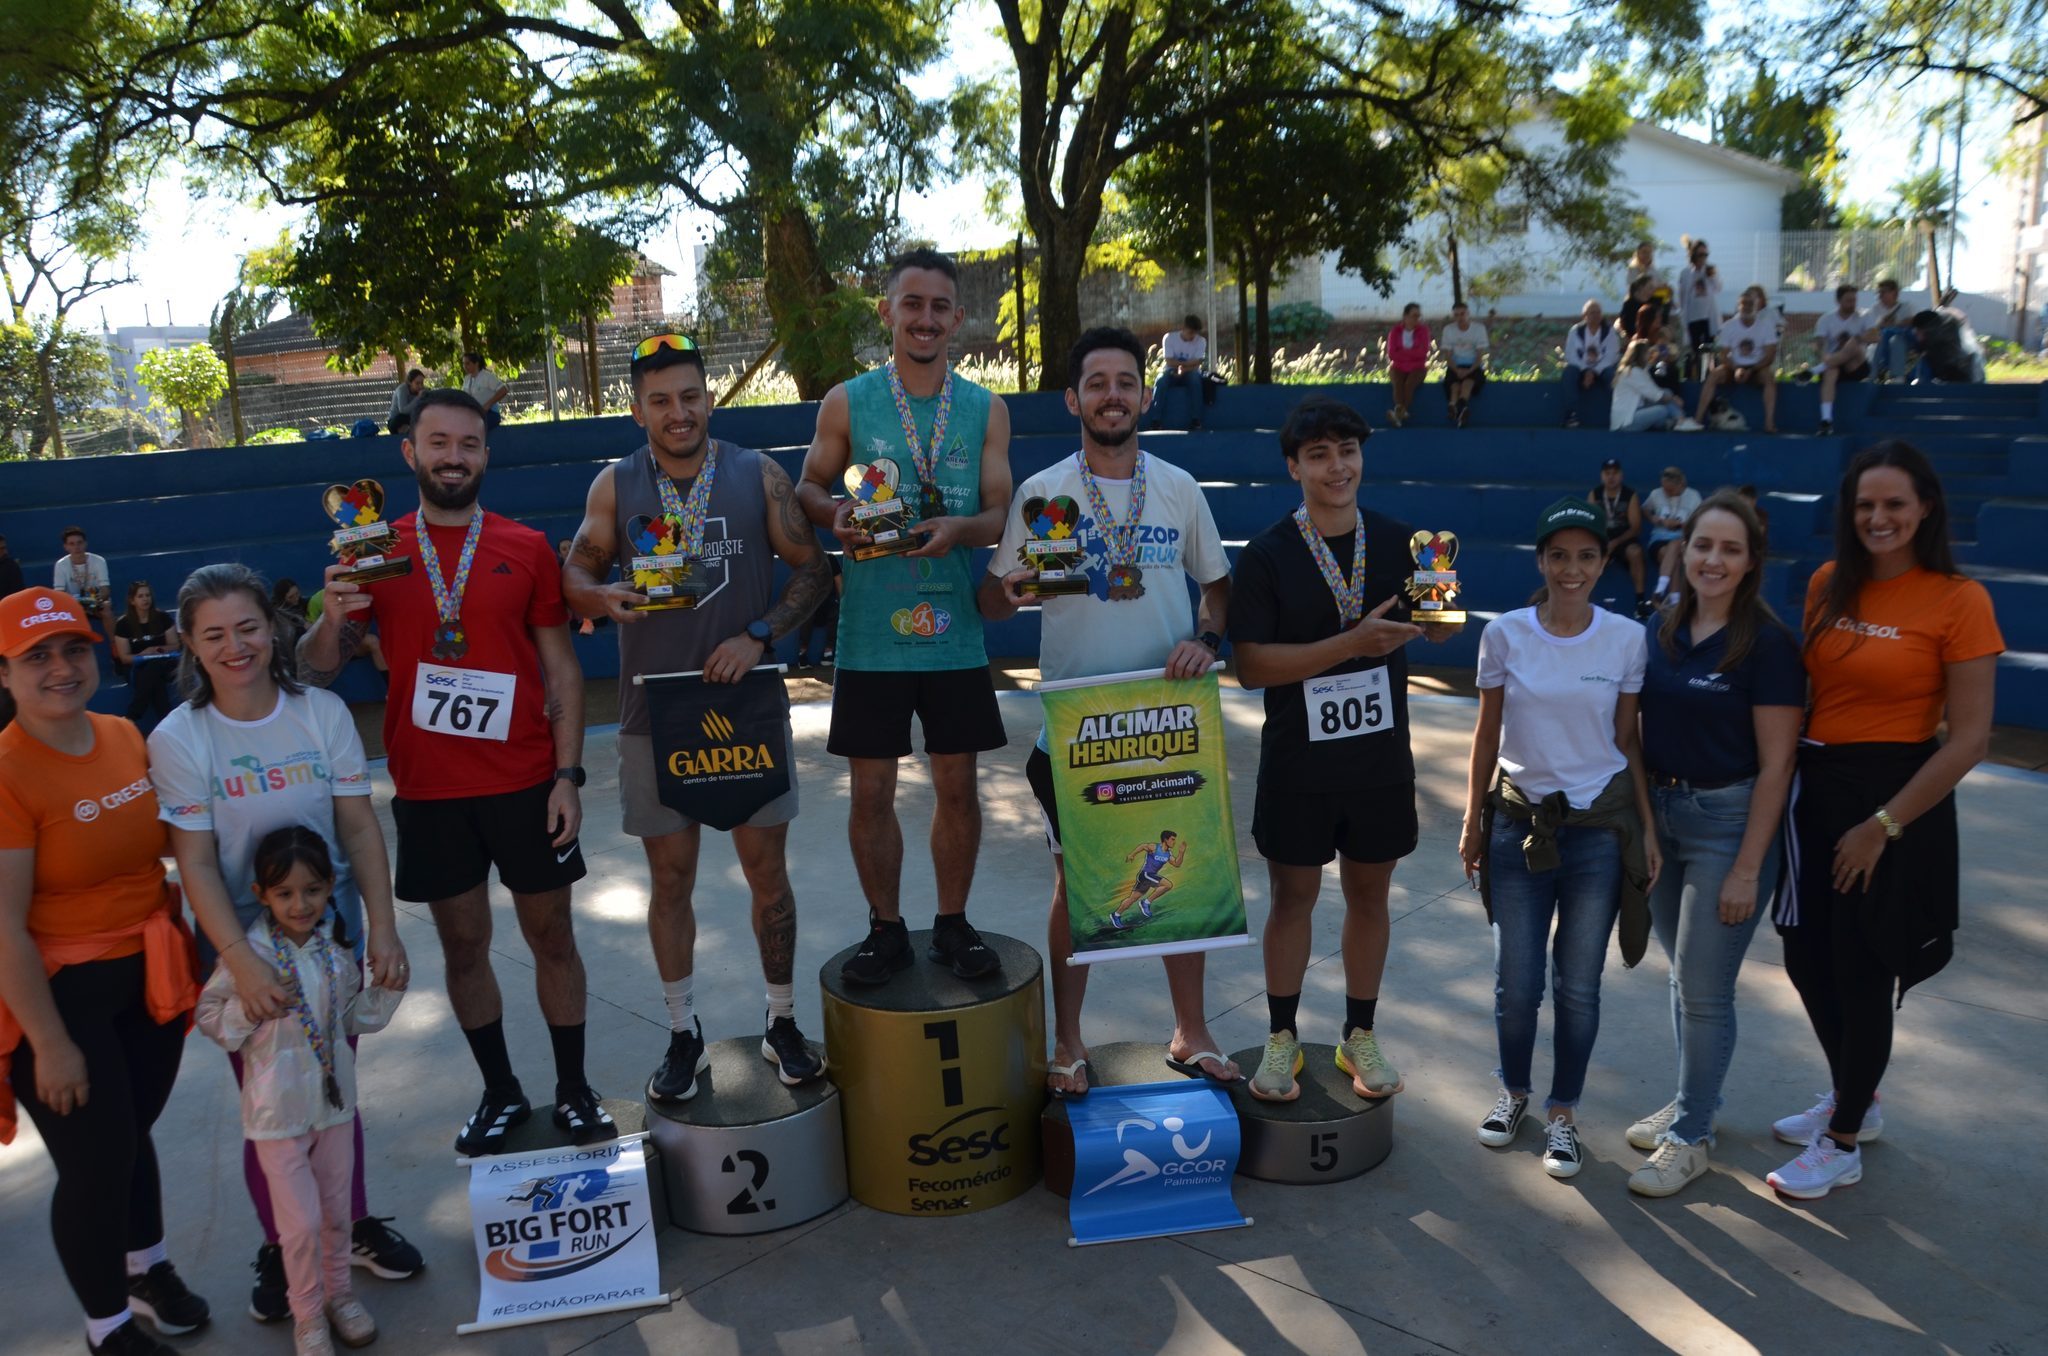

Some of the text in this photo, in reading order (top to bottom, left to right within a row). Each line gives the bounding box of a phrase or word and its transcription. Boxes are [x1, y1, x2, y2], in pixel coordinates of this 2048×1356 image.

[944, 456, 969, 464] ARENA
[700, 539, 744, 559] ROESTE
[20, 611, 77, 628] CRESOL
[428, 690, 499, 733] 767
[1078, 705, 1195, 742] ALCIMAR
[1320, 692, 1382, 734] 805
[668, 743, 775, 776] GARRA
[1071, 729, 1196, 766] HENRIQUE
[101, 777, 154, 810] CRESOL
[212, 763, 327, 800] Autismo
[683, 776, 708, 785] centro
[719, 772, 764, 781] treinamento
[1115, 775, 1194, 795] @prof_alcimarh
[924, 1019, 963, 1107] 1
[488, 1144, 627, 1176] ASSESSORIA
[1162, 1159, 1227, 1176] GCOR
[1310, 1132, 1338, 1172] 5
[721, 1149, 776, 1215] 2
[908, 1163, 1012, 1193] Fecomércio
[1163, 1174, 1222, 1188] Palmitinho
[911, 1194, 972, 1212] Senac
[485, 1200, 631, 1248] BIG FORT
[570, 1232, 611, 1253] RUN
